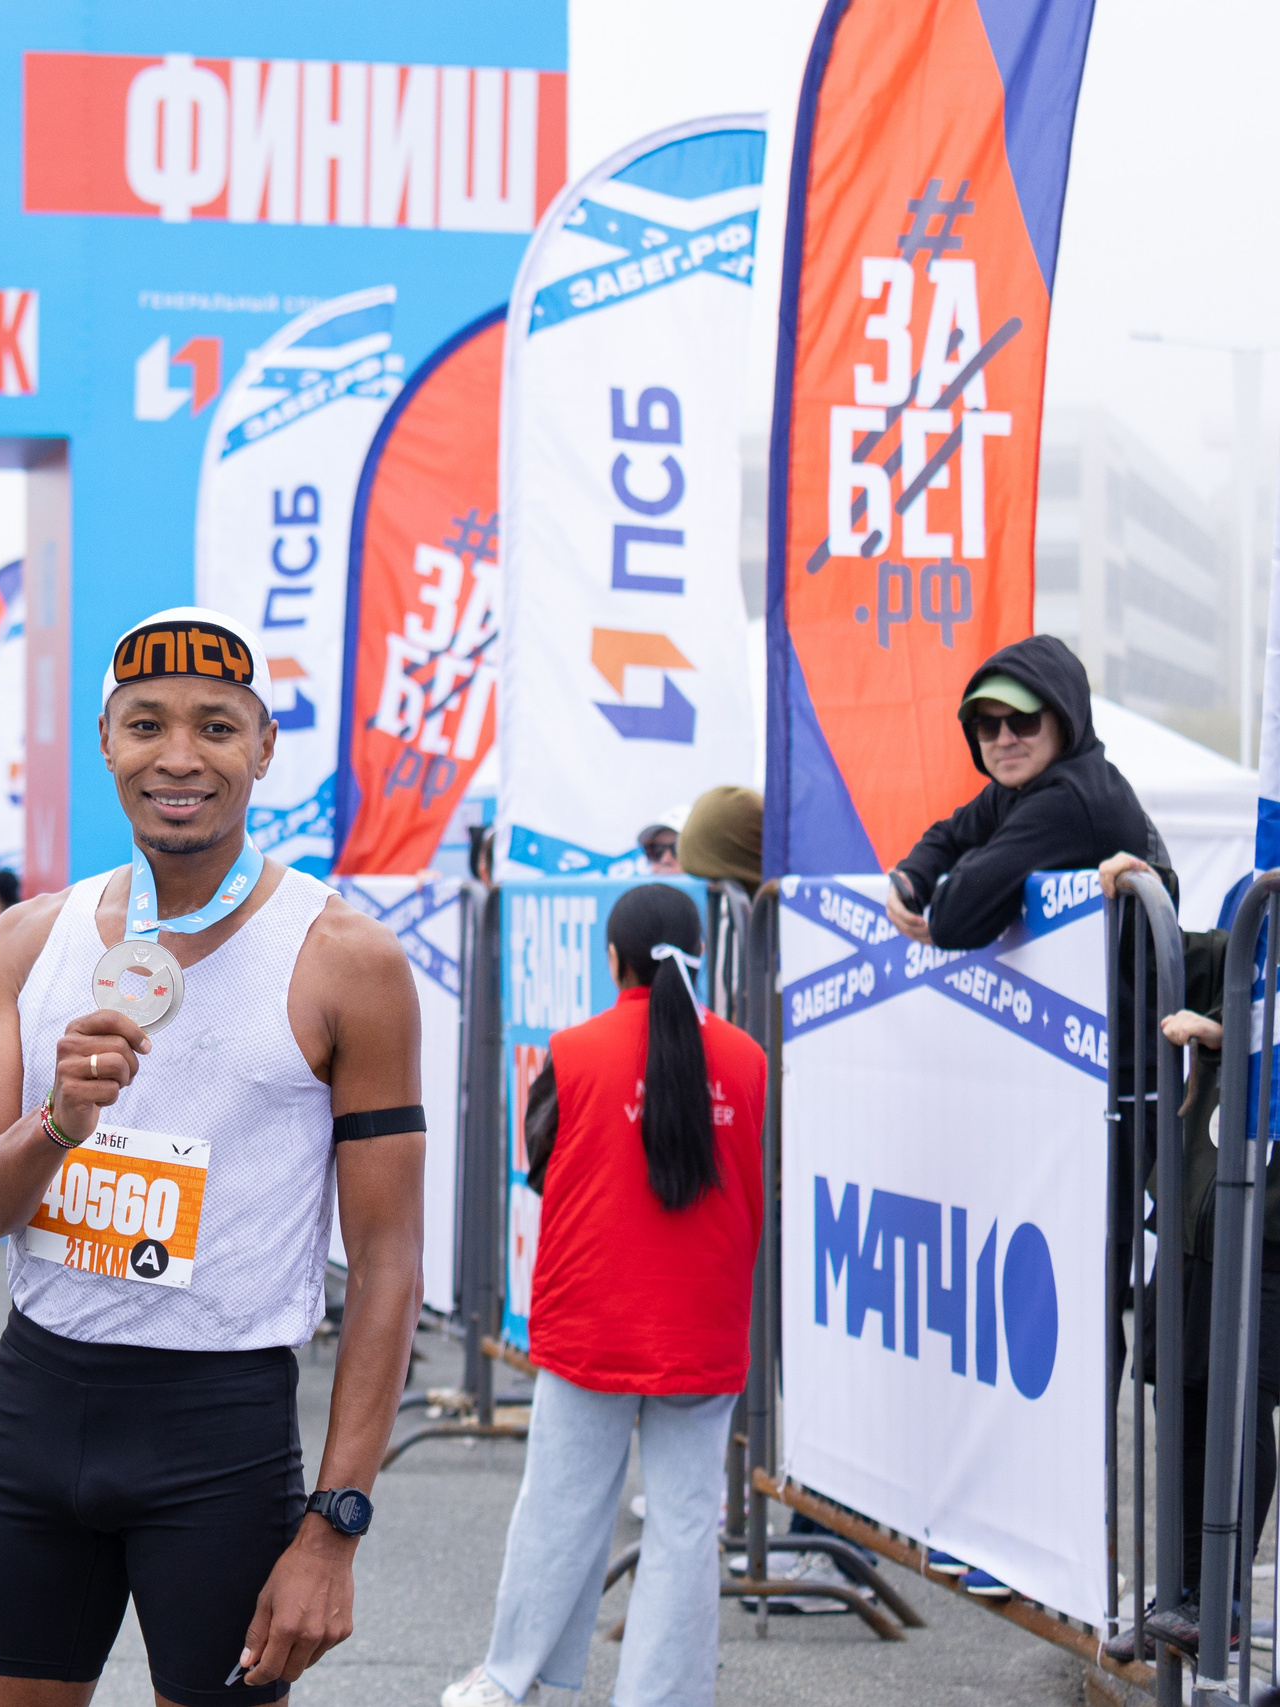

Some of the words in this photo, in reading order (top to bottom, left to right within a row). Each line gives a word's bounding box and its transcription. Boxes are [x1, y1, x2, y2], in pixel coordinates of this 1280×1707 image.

[125, 53, 538, 233] ФИНИШ
[568, 222, 753, 307] ЗАБЕГ.РФ
[609, 385, 686, 596] ПСБ
[263, 484, 321, 630] ПСБ
[227, 872, 249, 896] ПСБ
[791, 961, 876, 1027] ЗАБЕГ.РФ
[42, 1161, 181, 1242] 40560
